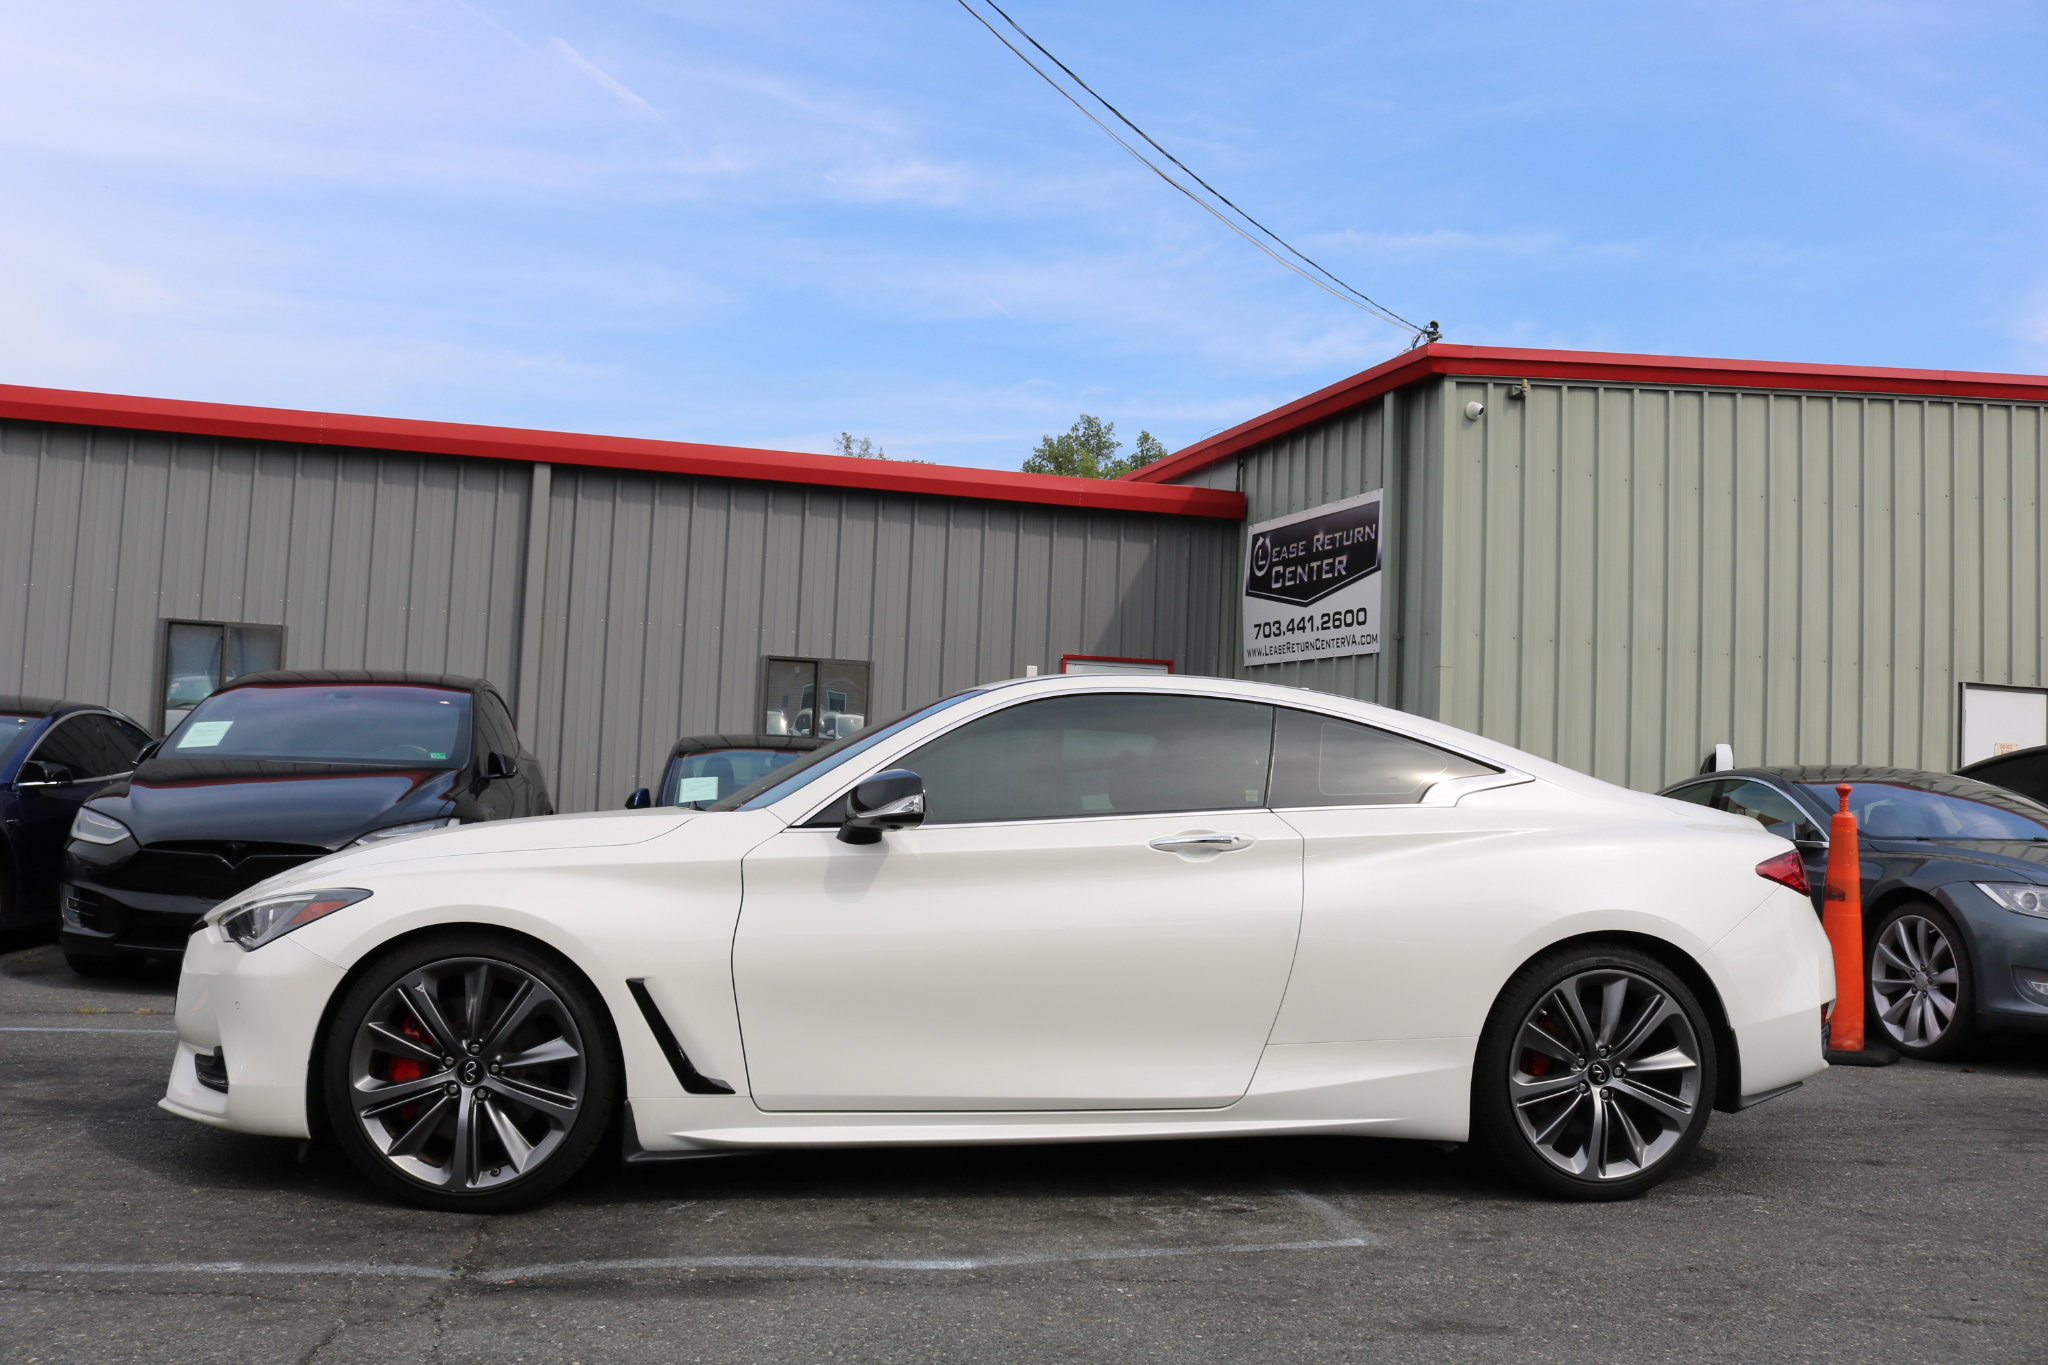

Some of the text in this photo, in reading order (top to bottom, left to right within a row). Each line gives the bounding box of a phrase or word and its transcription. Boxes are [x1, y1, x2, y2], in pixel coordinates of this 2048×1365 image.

[1313, 523, 1376, 553] RETURN
[1271, 555, 1348, 589] CENTER
[1253, 607, 1368, 640] 703.441.2600
